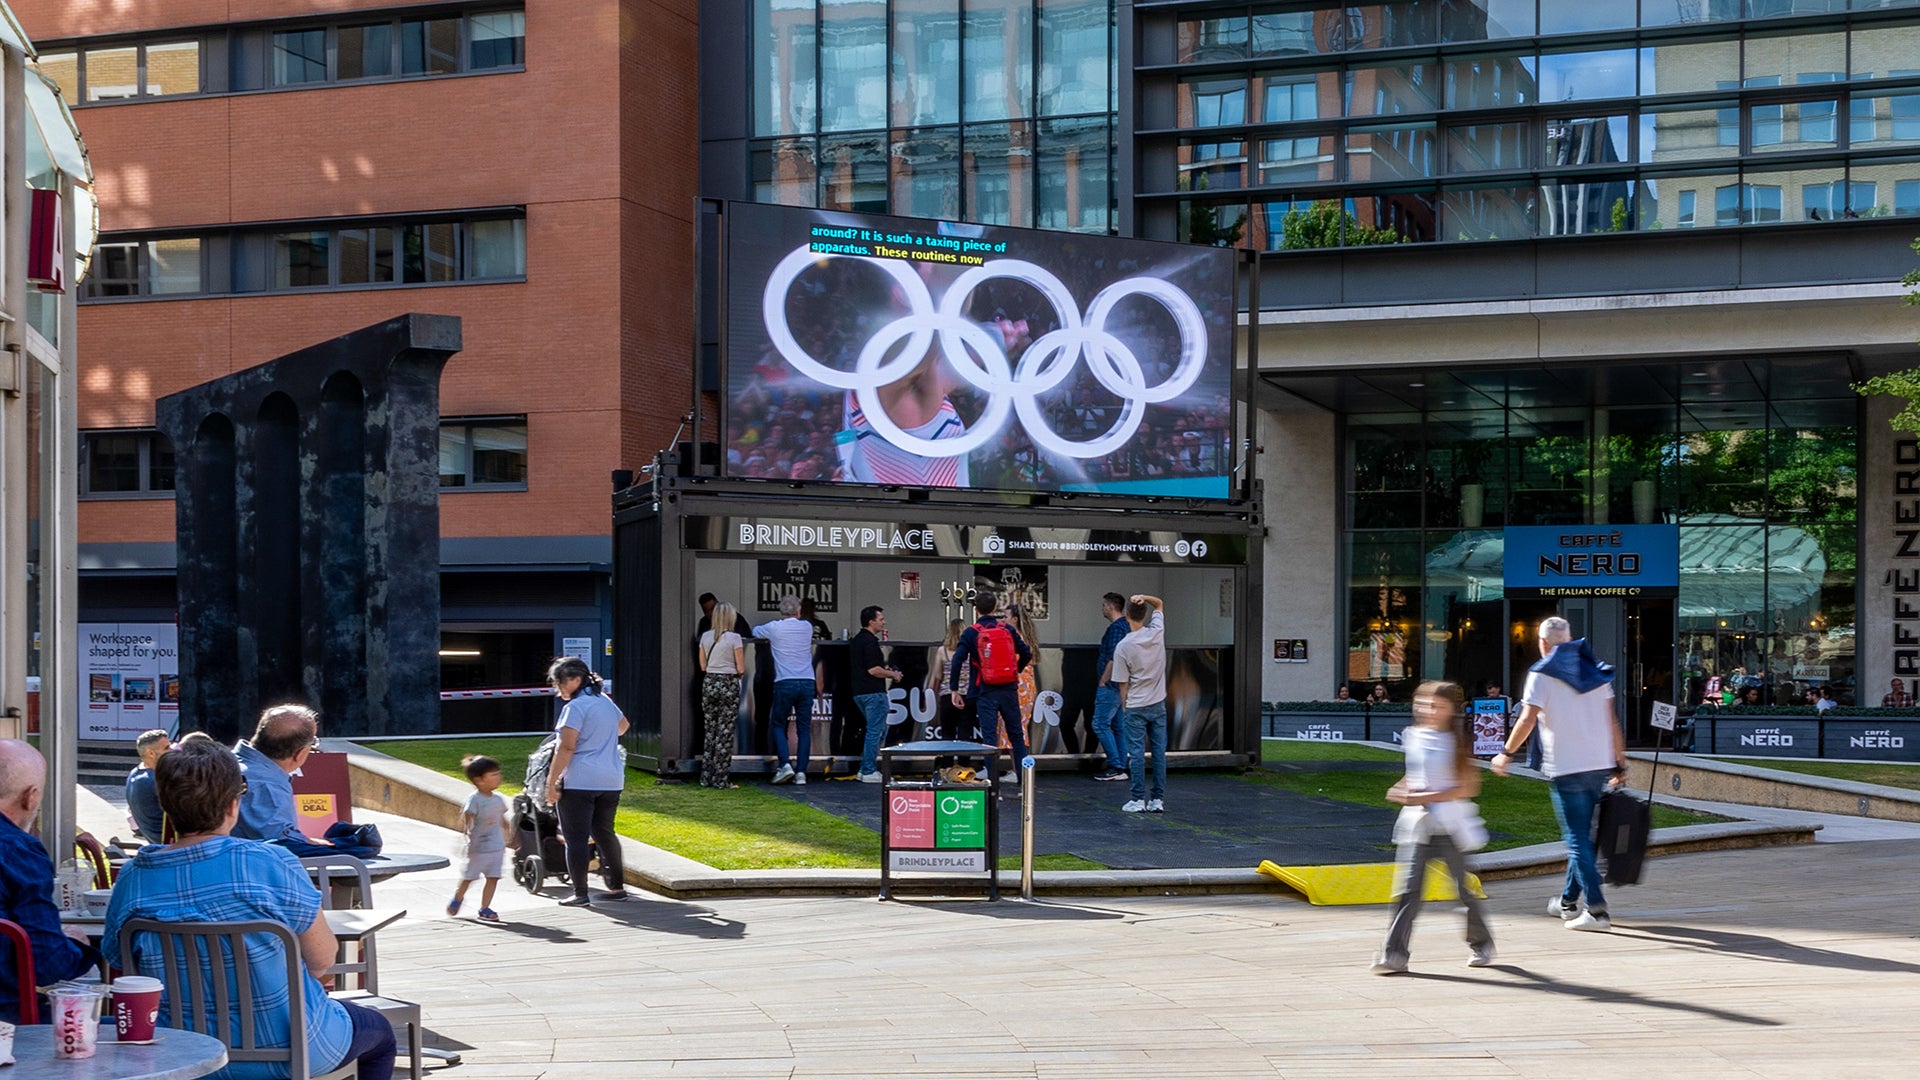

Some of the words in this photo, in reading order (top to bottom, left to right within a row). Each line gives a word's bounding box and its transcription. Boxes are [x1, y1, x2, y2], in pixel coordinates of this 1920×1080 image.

[811, 226, 857, 239] around?
[861, 230, 870, 241] It
[873, 230, 883, 242] is
[886, 232, 912, 245] such
[915, 236, 923, 245] a
[926, 235, 960, 251] taxing
[963, 238, 991, 252] piece
[994, 242, 1007, 253] of
[811, 242, 871, 255] apparatus.
[875, 246, 907, 258] These
[912, 249, 957, 262] routines
[960, 254, 983, 265] now
[1895, 439, 1920, 558] NERO
[739, 523, 934, 550] BRINDLEYPLACE
[1009, 541, 1034, 549] SHARE
[1036, 541, 1059, 550] YOUR
[1060, 542, 1136, 552] #BRINDLEYMOMENT
[1138, 544, 1158, 553] WITH
[1160, 545, 1170, 553] US
[1538, 553, 1640, 576] NERO
[762, 583, 832, 602] INDIAN
[1540, 588, 1555, 596] THE
[1557, 588, 1592, 596] ITALIAN
[1594, 588, 1626, 596] COFFEE
[89, 633, 152, 646] Workspace
[89, 645, 130, 659] shaped
[133, 645, 150, 657] for
[152, 648, 176, 660] you.
[1297, 731, 1343, 741] NERO
[1741, 735, 1793, 746] NERO
[1850, 736, 1904, 748] NERO
[899, 857, 974, 866] BRINDLEYPLACE
[118, 1002, 128, 1034] COSTA
[64, 1010, 75, 1054] COSTA
